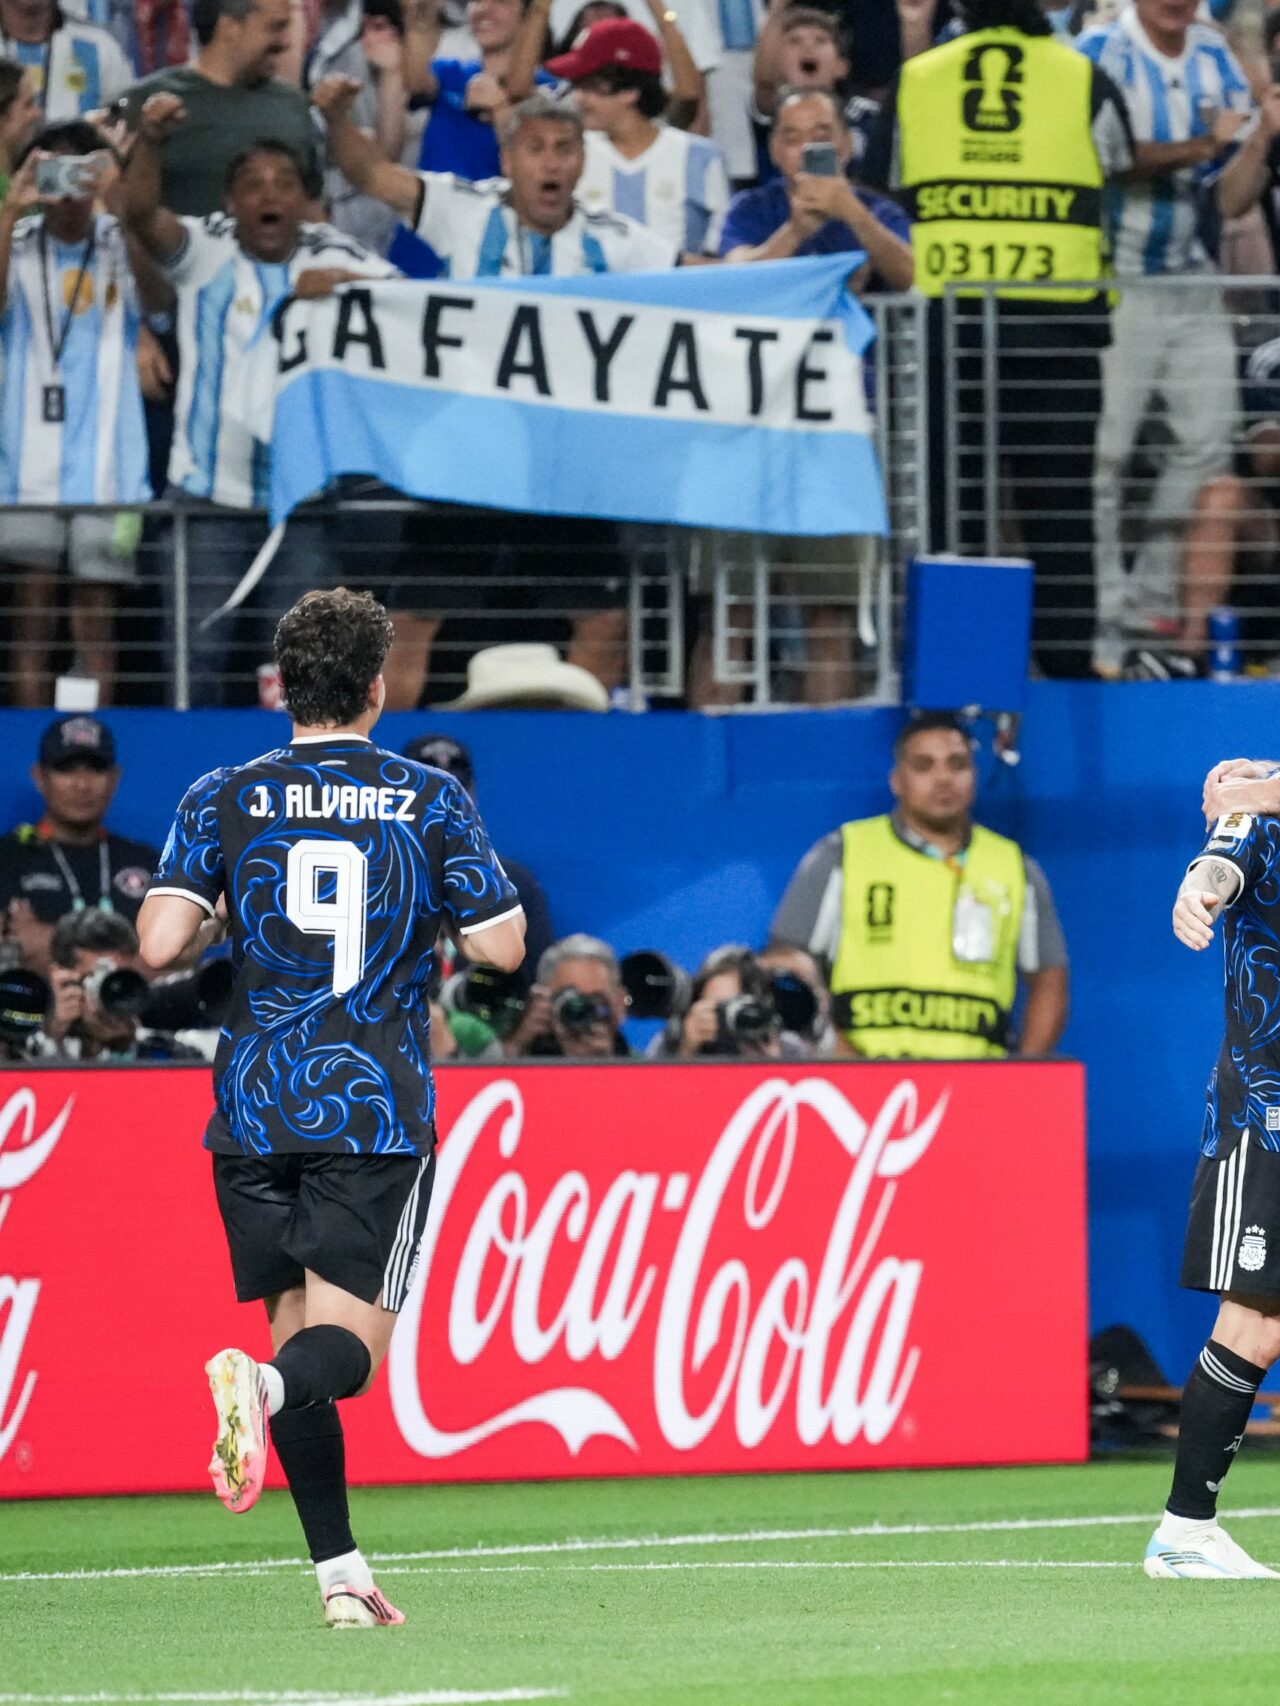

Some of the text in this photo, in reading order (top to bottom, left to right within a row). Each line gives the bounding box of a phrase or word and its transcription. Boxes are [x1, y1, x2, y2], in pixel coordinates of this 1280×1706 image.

[916, 184, 1076, 220] SECURITY
[926, 243, 1054, 280] 03173
[250, 784, 417, 822] J. ALVAREZ
[286, 839, 369, 998] 9
[388, 1079, 952, 1459] Coca-Cola
